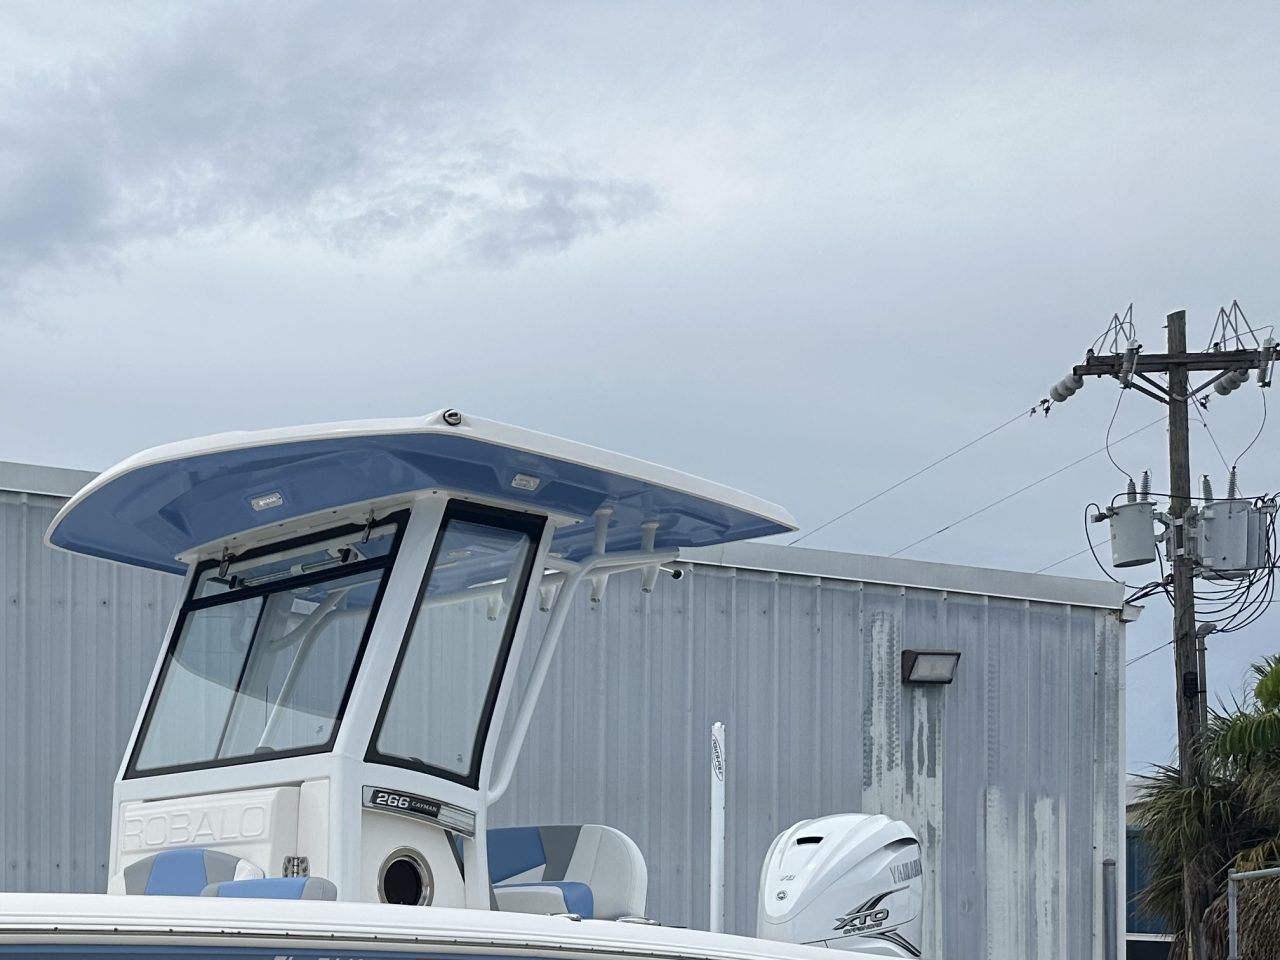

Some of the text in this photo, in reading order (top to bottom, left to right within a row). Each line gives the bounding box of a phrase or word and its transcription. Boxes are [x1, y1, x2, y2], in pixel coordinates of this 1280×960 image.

[376, 792, 438, 813] 266 CAYMAN
[123, 804, 266, 849] ROBALO
[832, 908, 889, 931] XTO
